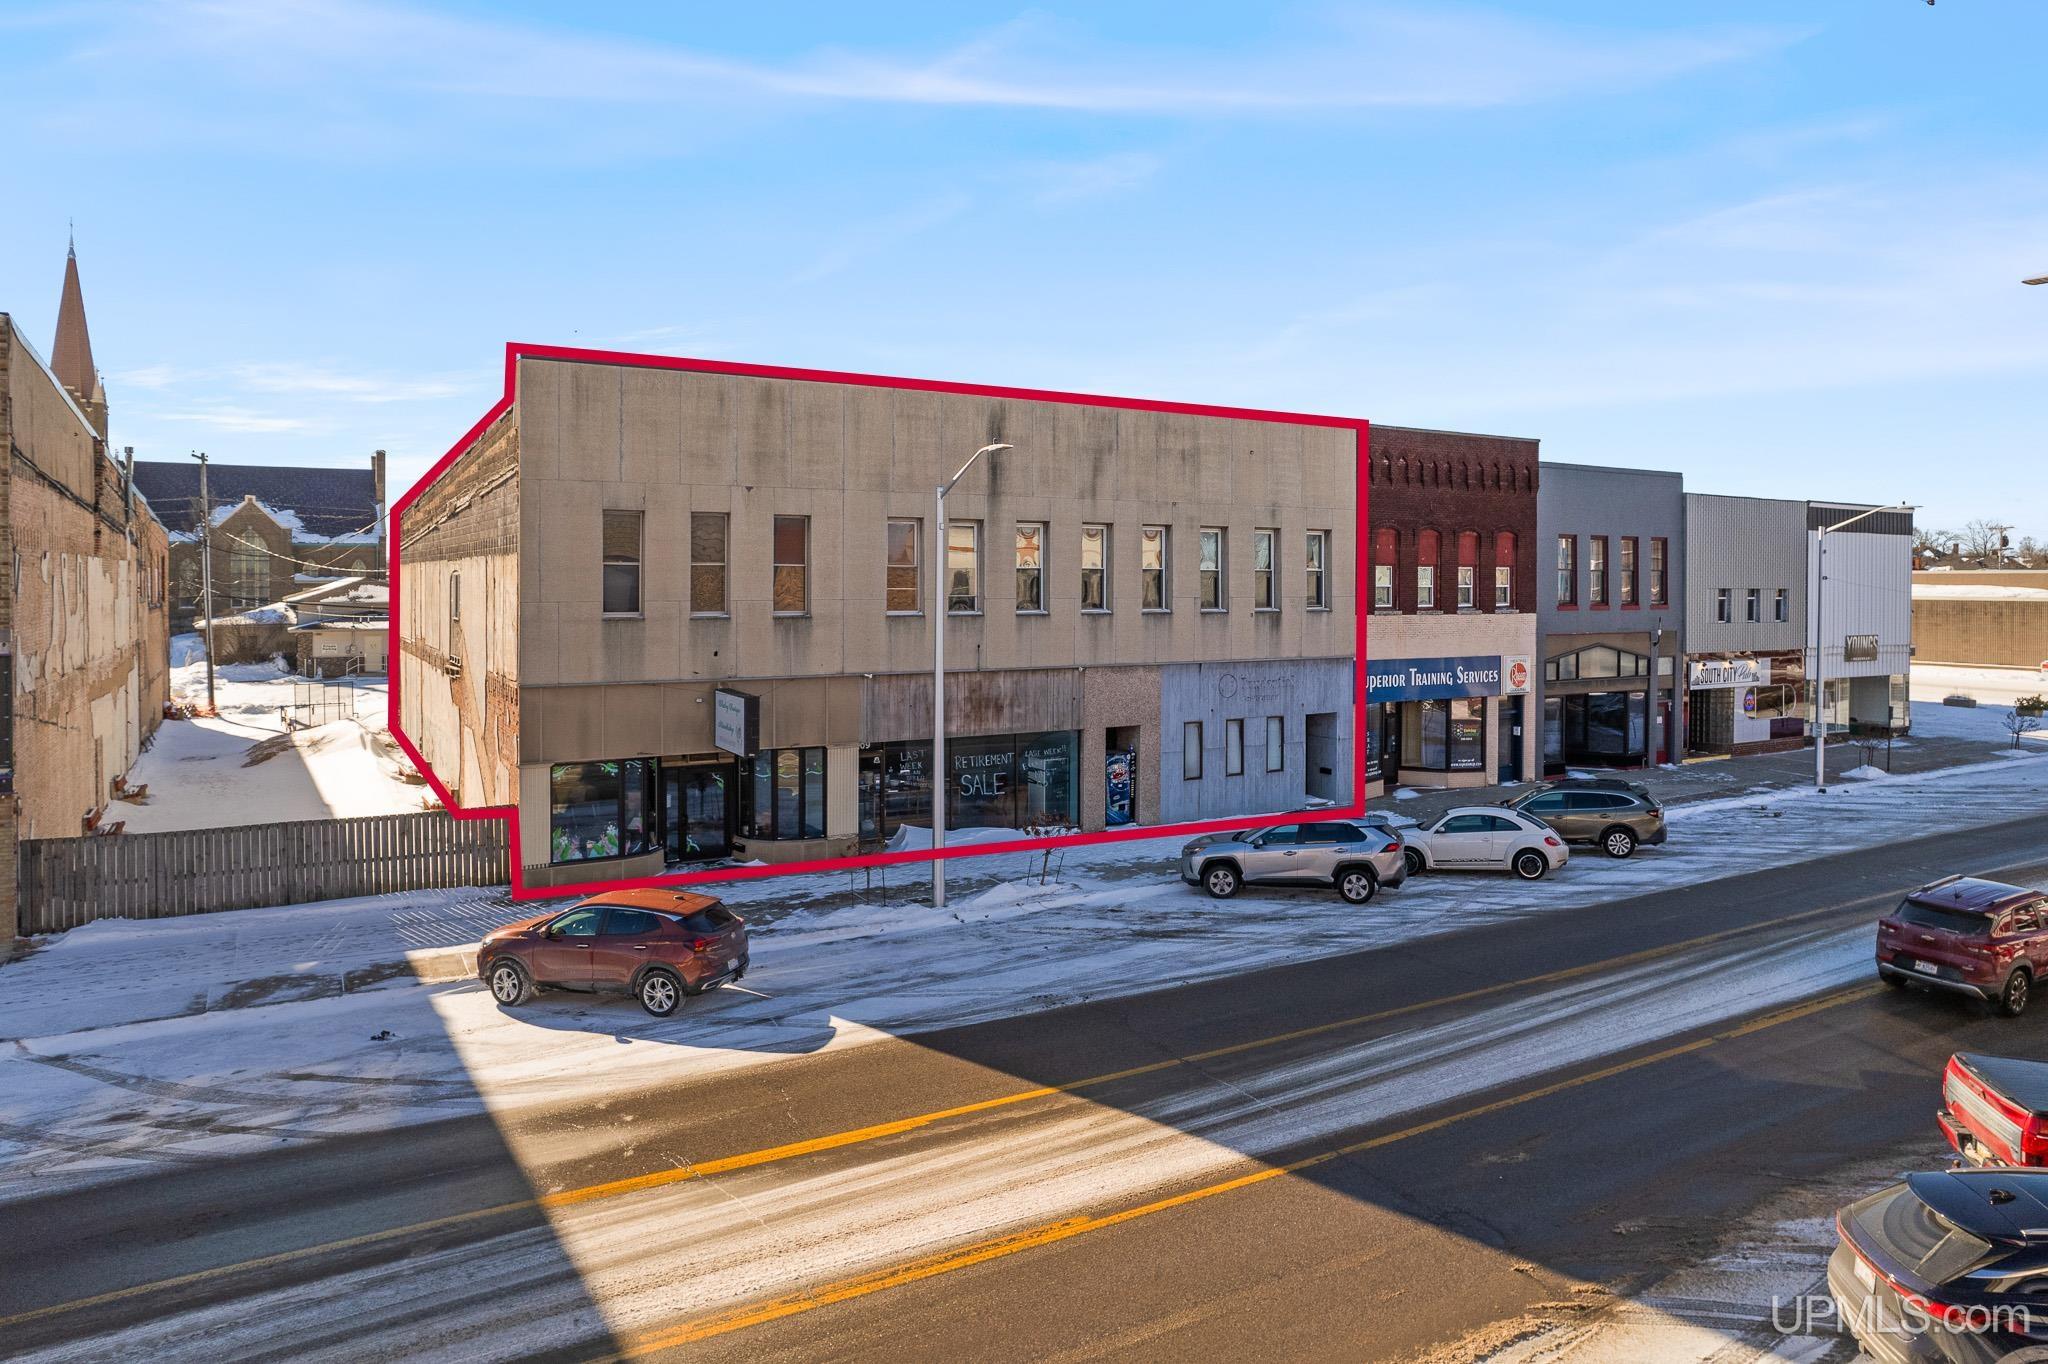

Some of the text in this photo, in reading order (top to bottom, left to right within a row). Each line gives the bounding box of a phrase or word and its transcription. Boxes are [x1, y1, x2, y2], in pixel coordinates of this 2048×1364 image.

[1700, 668, 1721, 684] SOUTH
[1723, 667, 1737, 682] CITY
[900, 749, 926, 762] LAST
[954, 752, 1015, 769] RETIREMENT
[960, 771, 1007, 796] SALE
